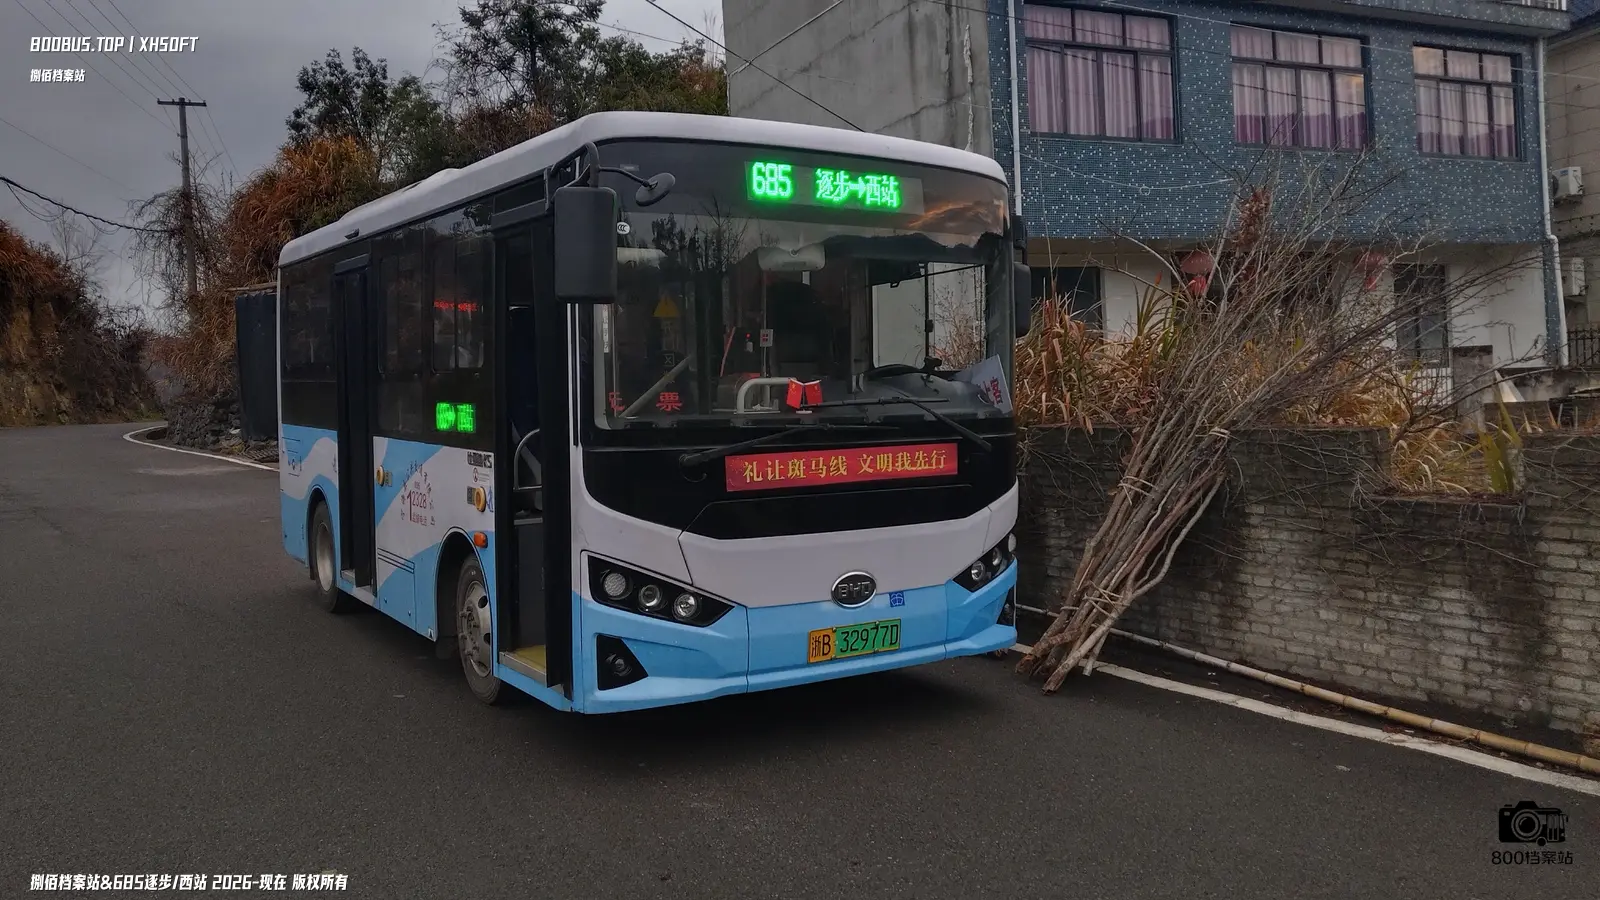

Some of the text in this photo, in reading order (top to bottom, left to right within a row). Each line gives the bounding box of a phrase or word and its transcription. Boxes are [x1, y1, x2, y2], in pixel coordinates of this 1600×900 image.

[752, 162, 793, 197] 685
[743, 450, 947, 483] 礼让斑马线 文明我先行
[406, 490, 427, 521] 12328
[838, 581, 871, 597] BYD
[811, 624, 899, 657] 浙B 32977D
